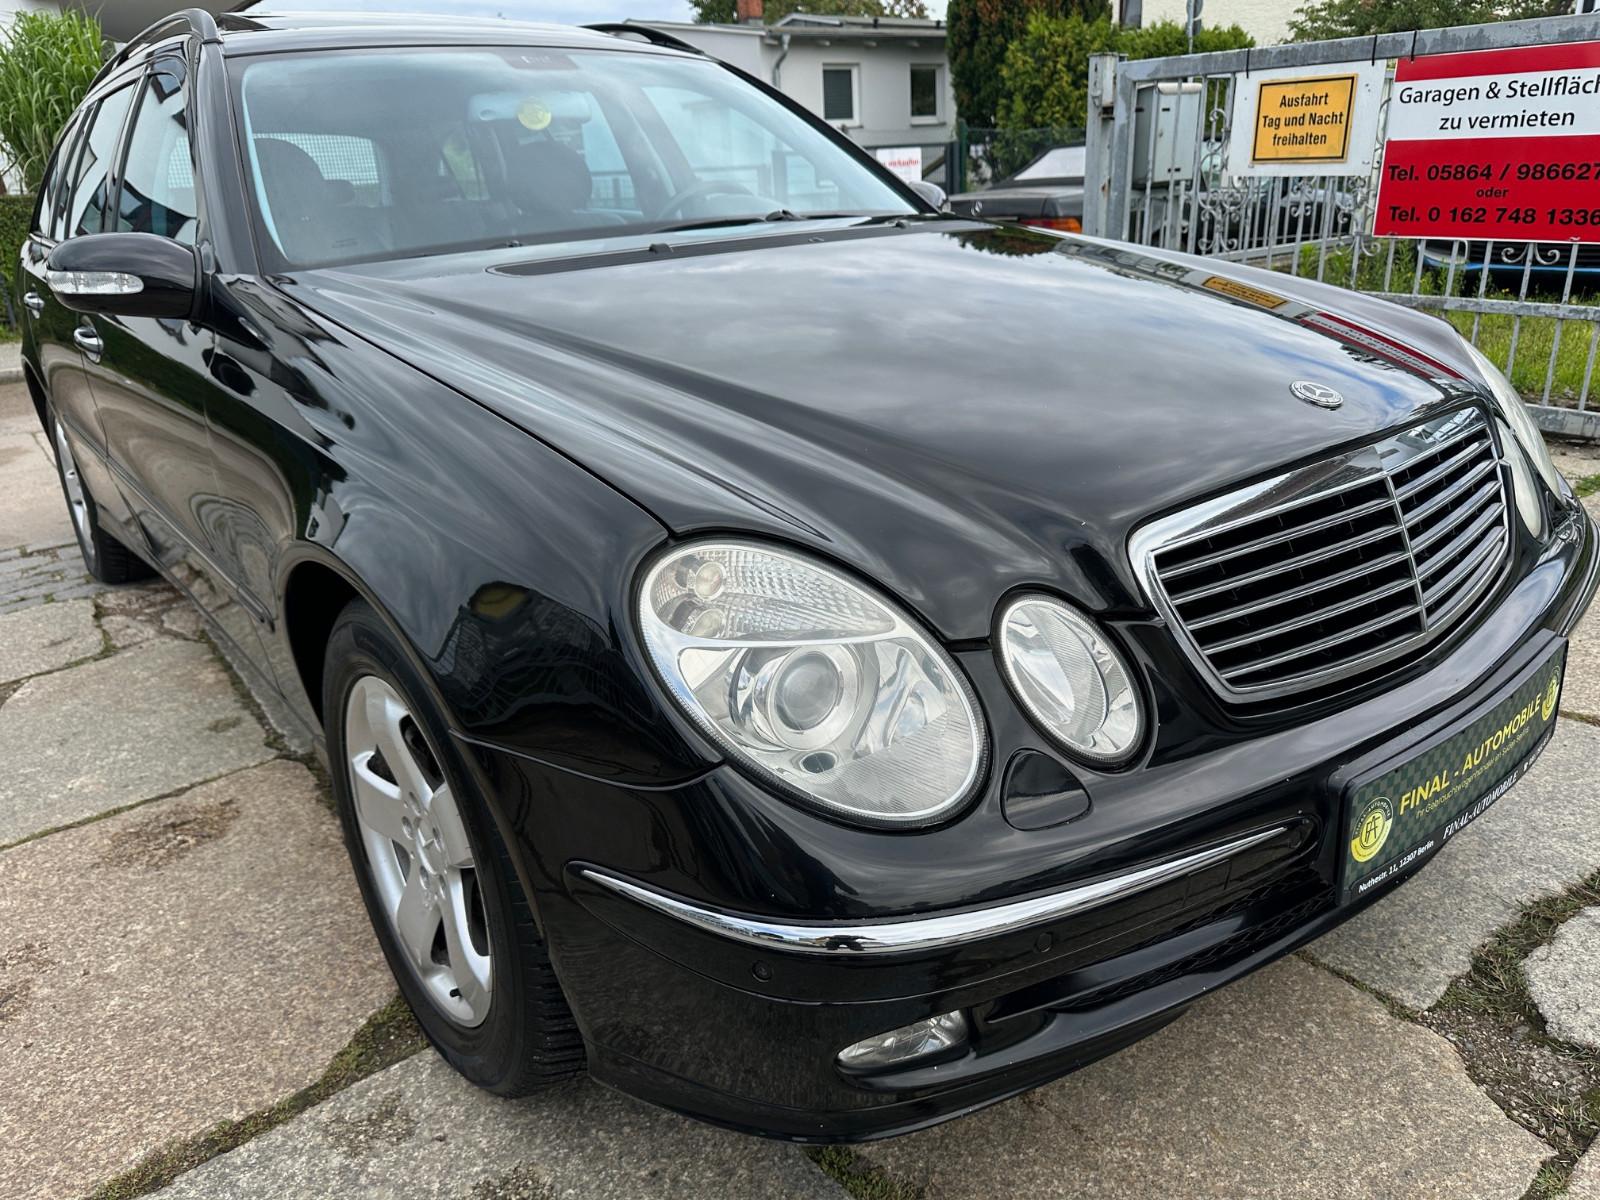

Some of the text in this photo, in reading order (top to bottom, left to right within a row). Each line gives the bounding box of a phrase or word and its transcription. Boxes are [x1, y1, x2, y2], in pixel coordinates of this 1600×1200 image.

[1279, 92, 1329, 108] Ausfahrt
[1399, 86, 1480, 106] Garagen
[1485, 81, 1501, 99] &
[1262, 111, 1344, 130] Tag und Nacht
[1439, 110, 1576, 130] zu vermieten
[1272, 132, 1327, 146] freihalten
[1388, 164, 1420, 181] Tel.
[1427, 164, 1493, 181] 05864
[1499, 163, 1511, 181] /
[1476, 186, 1509, 198] oder
[1389, 206, 1600, 226] Tel. 0 162 748 1336
[1400, 769, 1450, 816] FINAL
[1462, 693, 1541, 776] AUTOMOBILE
[1358, 871, 1389, 894] Nuthestr.
[1398, 849, 1418, 869] 12307
[1417, 840, 1435, 857] Berlin
